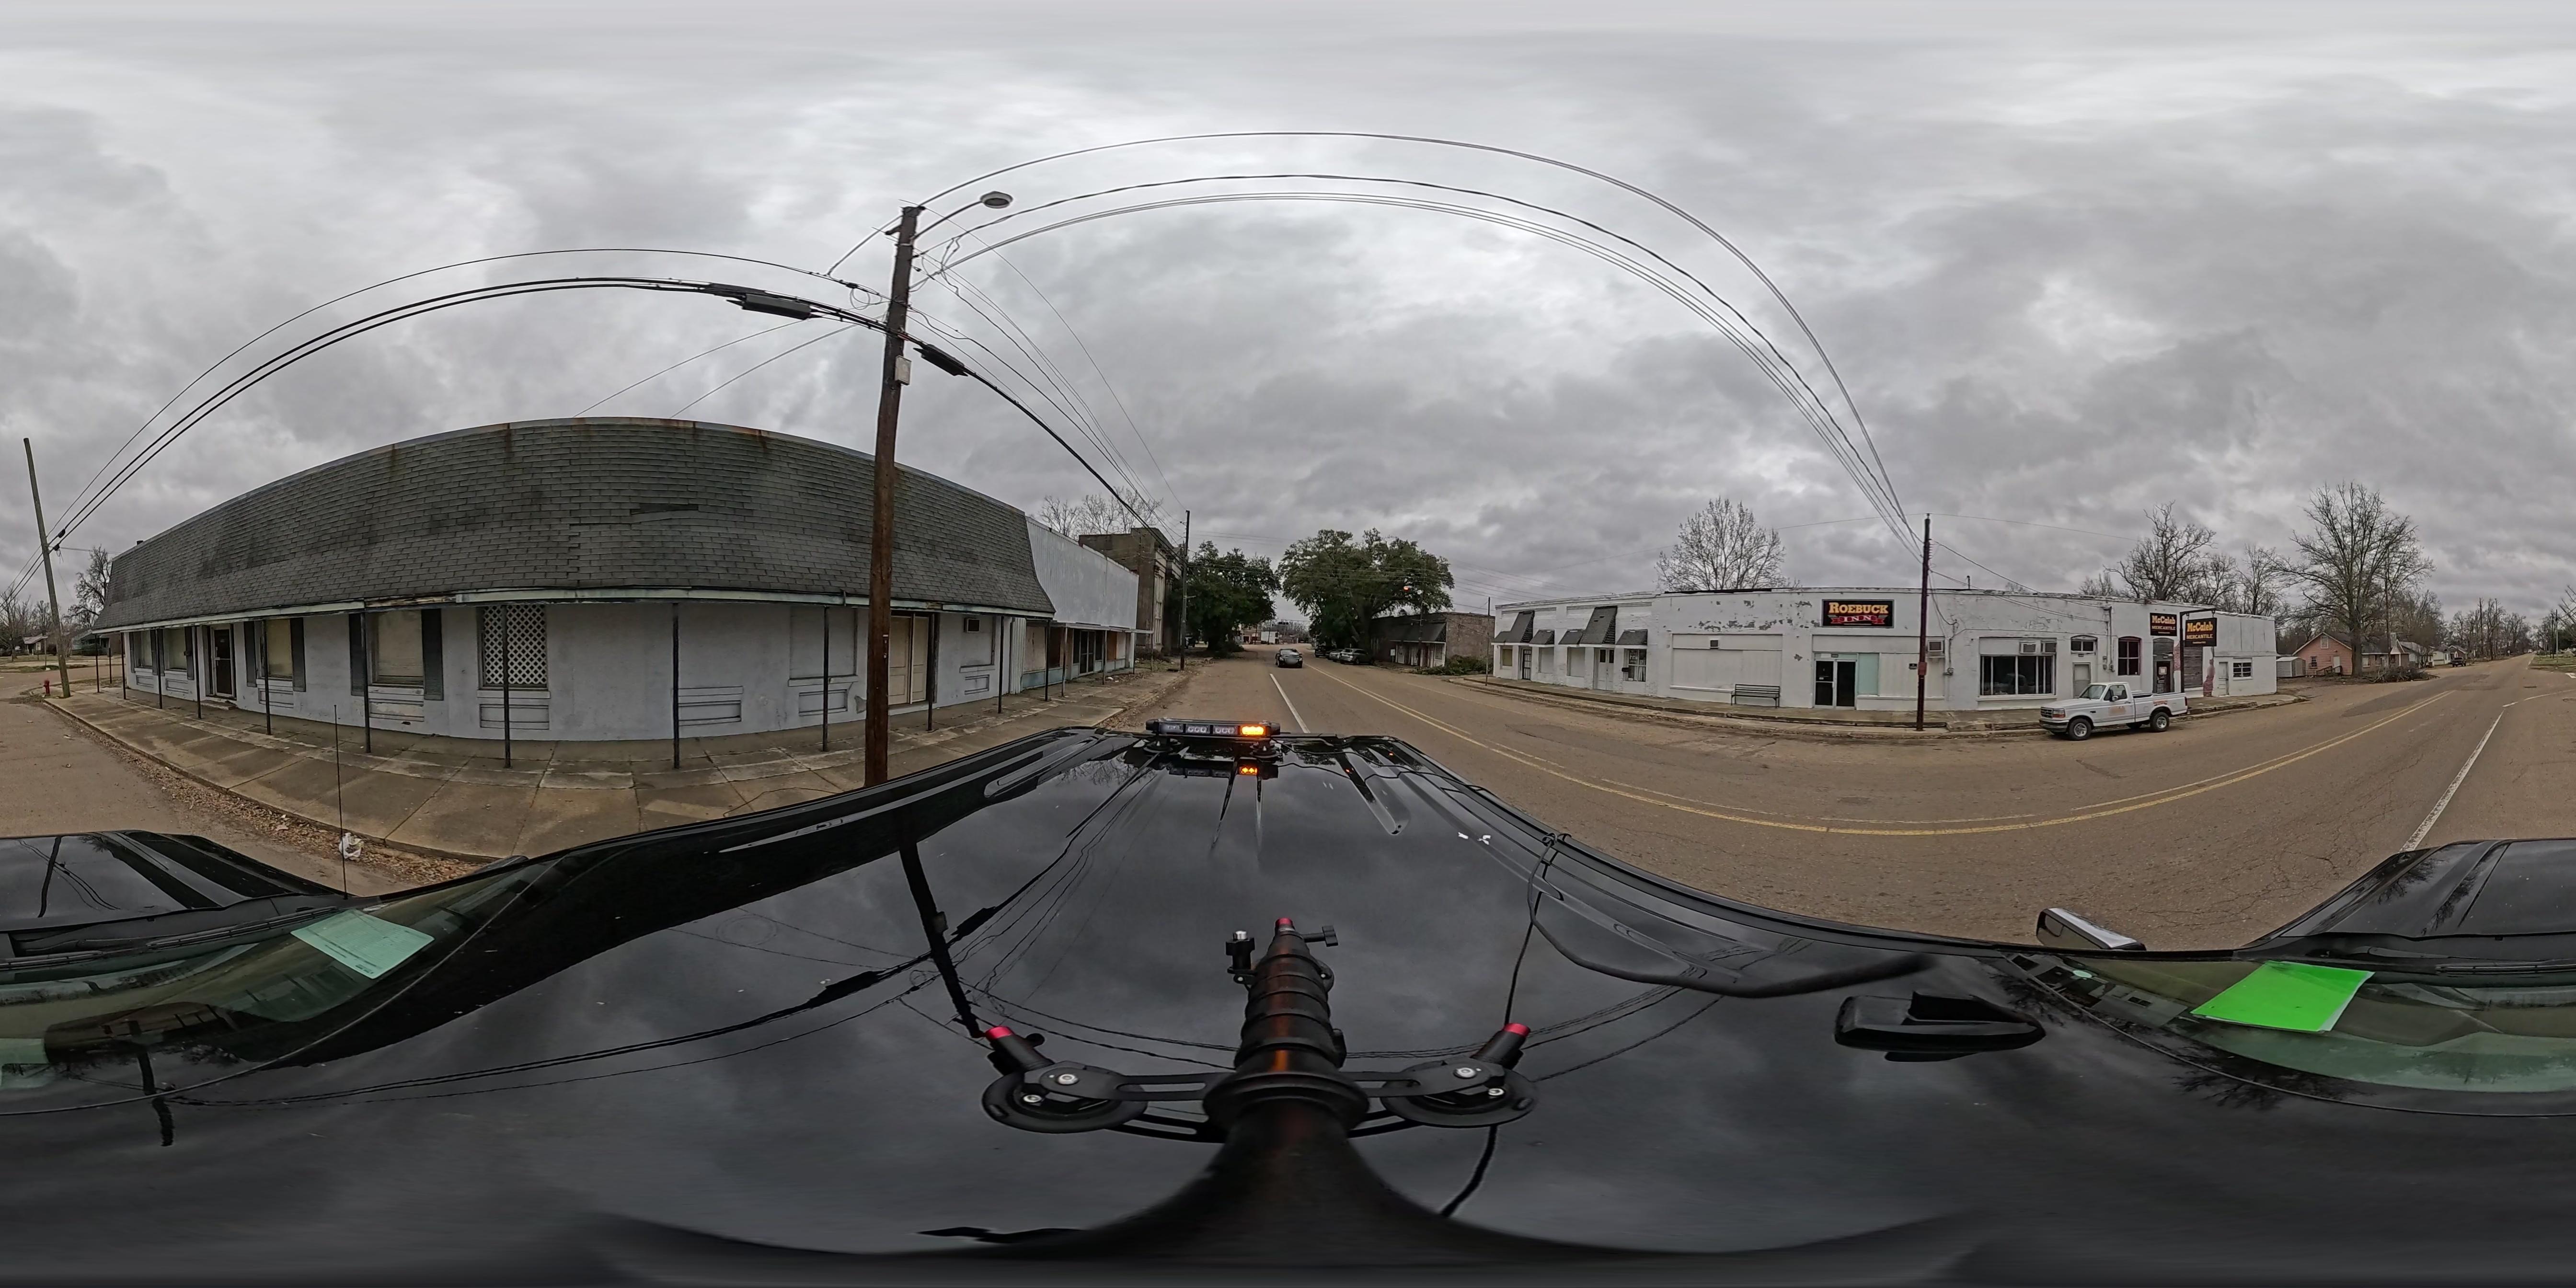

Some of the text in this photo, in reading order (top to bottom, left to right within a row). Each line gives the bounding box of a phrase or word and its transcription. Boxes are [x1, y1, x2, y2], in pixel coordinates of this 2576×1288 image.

[1828, 602, 1889, 614] ROEBUCK
[2151, 615, 2176, 624] McCaleb
[2187, 621, 2213, 632] McCaleb
